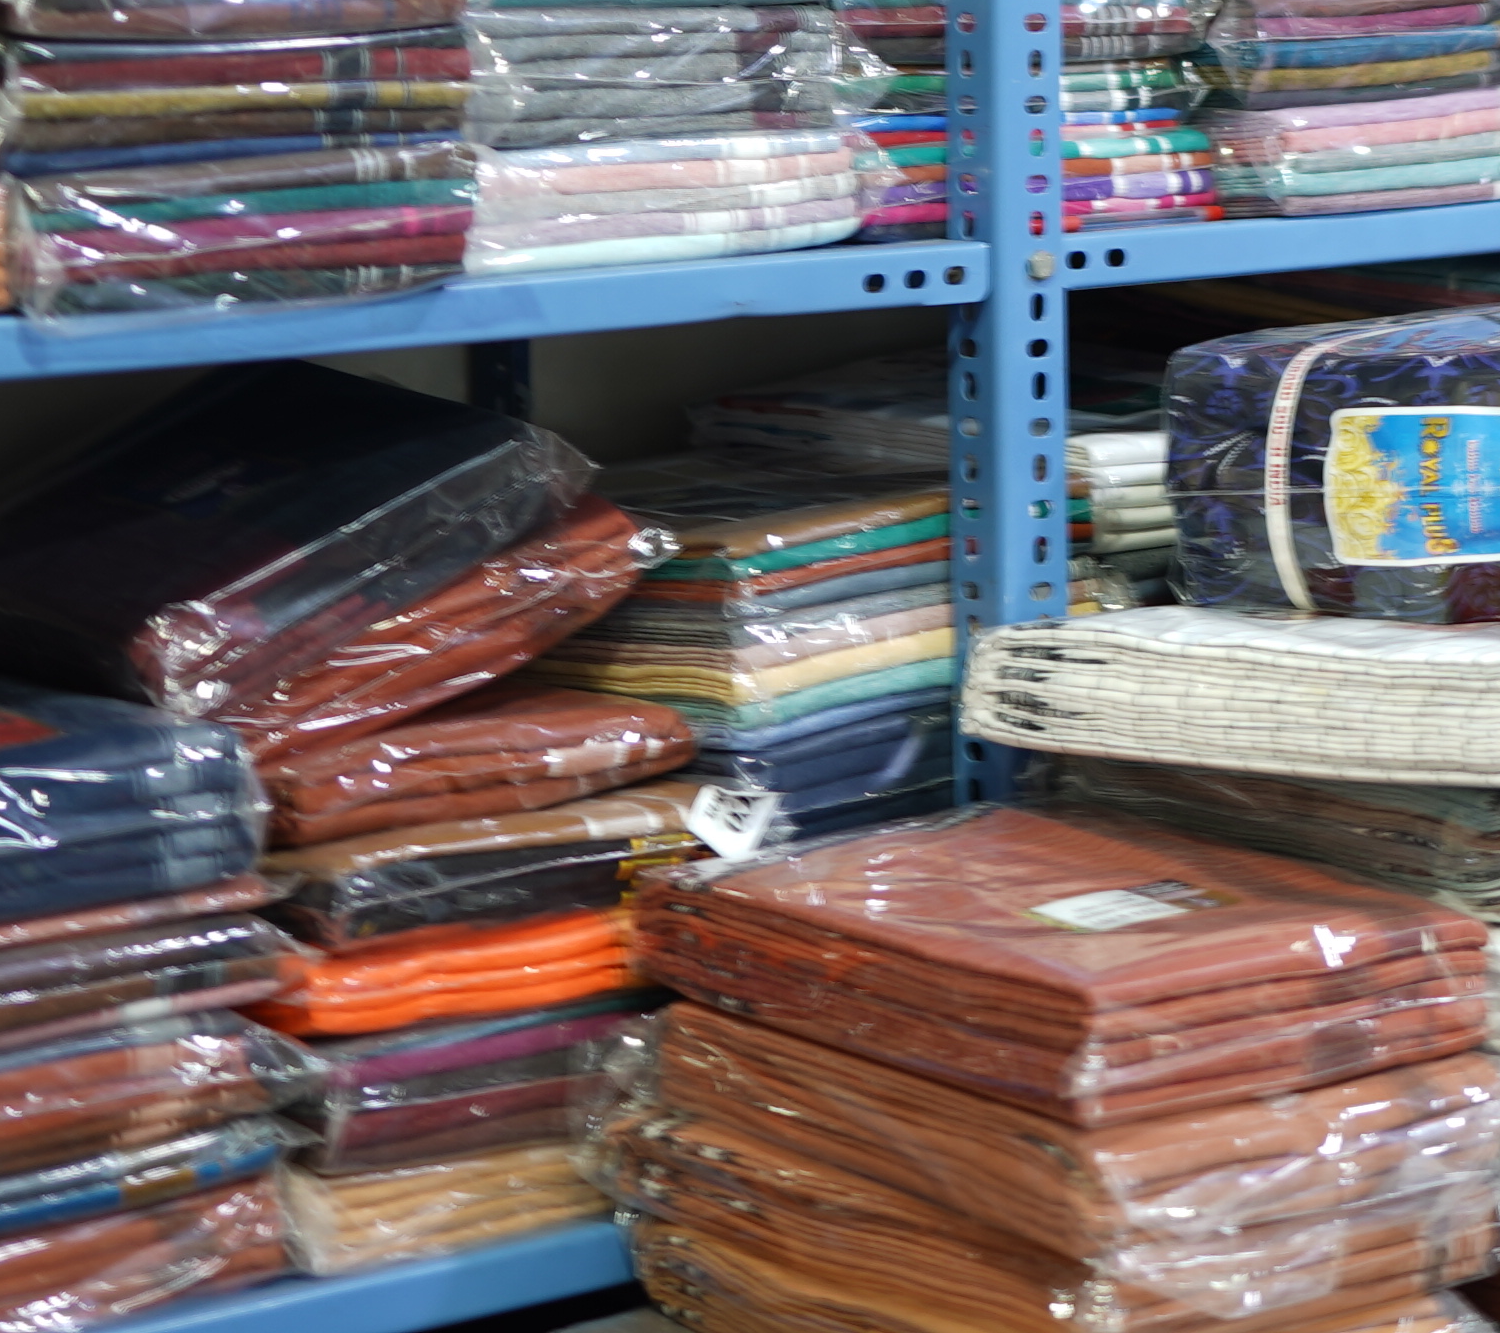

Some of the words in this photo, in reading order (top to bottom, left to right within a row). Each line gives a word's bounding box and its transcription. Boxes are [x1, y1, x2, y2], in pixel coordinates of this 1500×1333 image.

[1418, 416, 1453, 495] ROYAL
[1269, 463, 1288, 507] INDIA
[1418, 503, 1460, 553] PLUS
